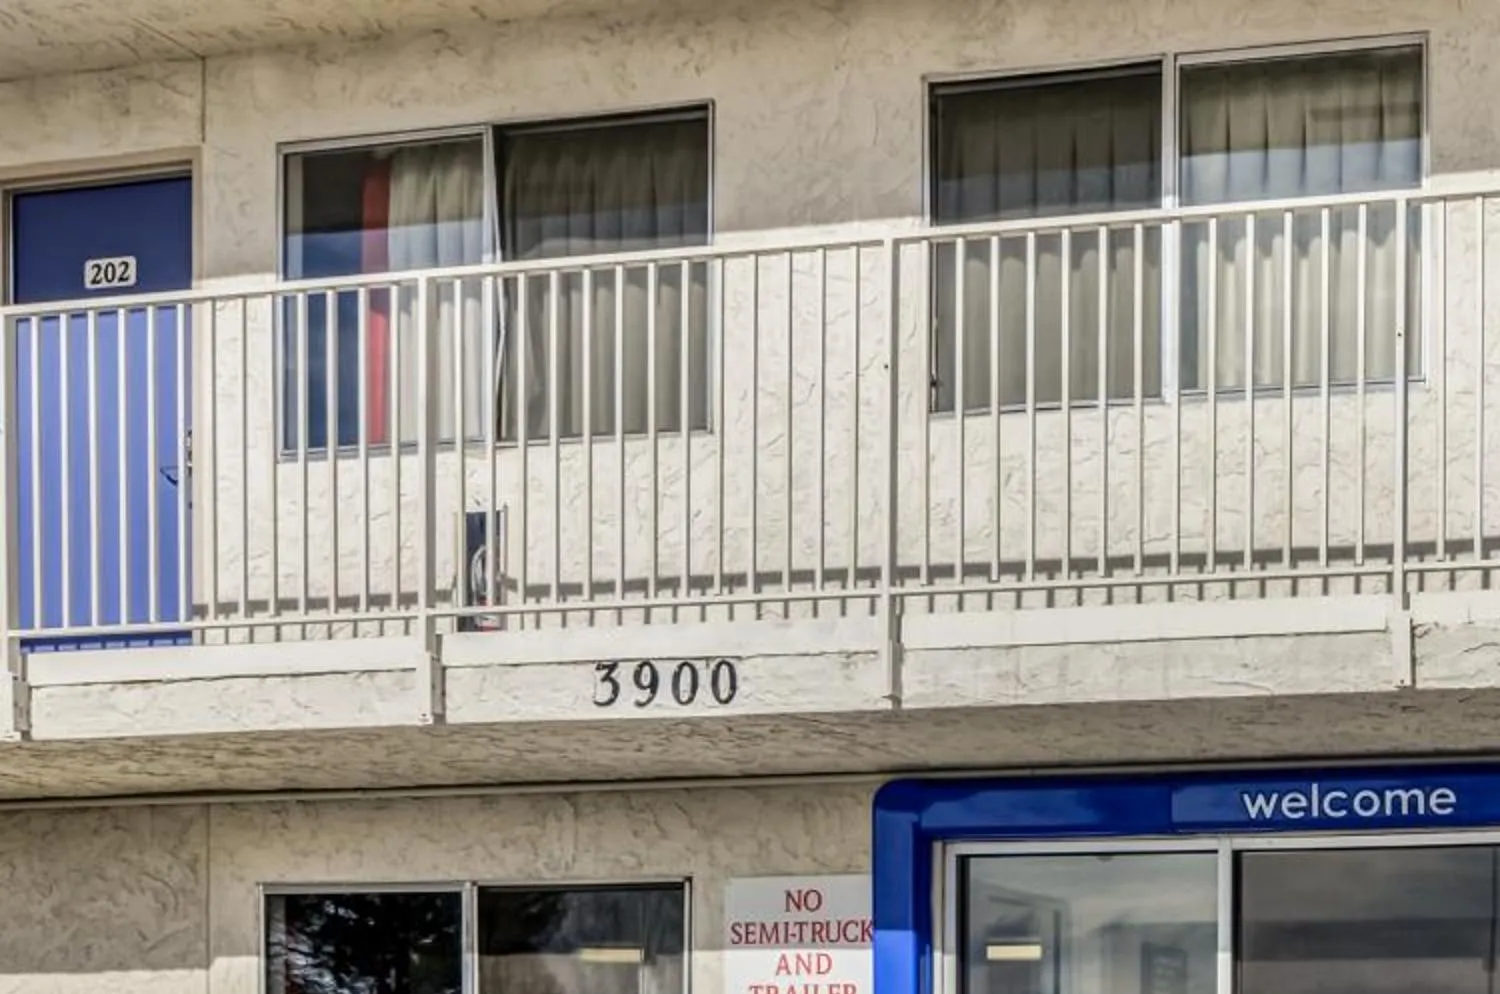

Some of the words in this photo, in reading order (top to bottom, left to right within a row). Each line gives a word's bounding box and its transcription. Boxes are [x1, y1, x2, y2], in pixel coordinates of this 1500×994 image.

[90, 260, 130, 285] 202
[593, 658, 737, 708] 3900
[1242, 782, 1457, 820] welcome
[784, 889, 823, 913] NO
[730, 919, 874, 946] SEMI-TRUCK
[775, 952, 832, 976] AND
